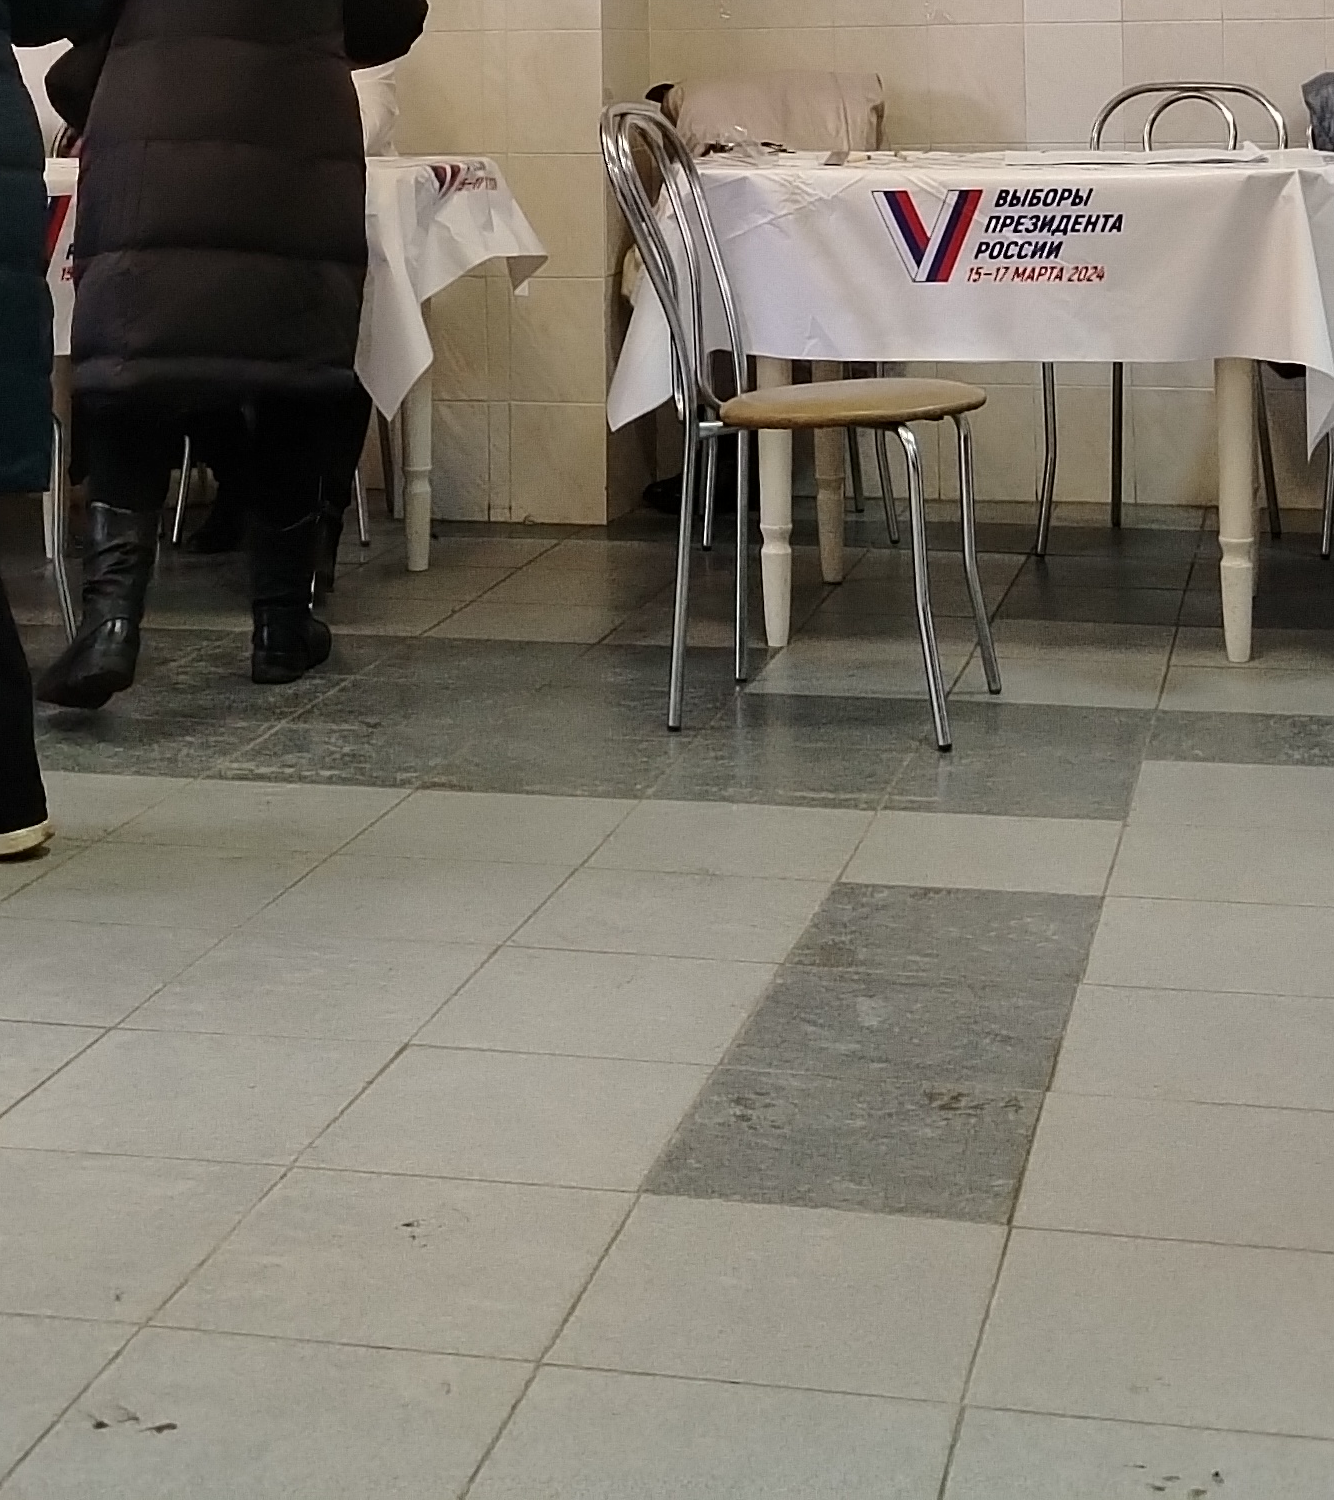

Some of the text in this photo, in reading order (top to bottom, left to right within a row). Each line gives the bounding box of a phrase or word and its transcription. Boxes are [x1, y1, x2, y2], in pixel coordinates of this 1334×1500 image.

[993, 187, 1094, 208] ВЫБОРЫ
[983, 213, 1124, 237] ПРЕЗИДЕНТА
[973, 240, 1064, 260] РОССИИ
[1012, 266, 1064, 283] МАРТА
[1067, 265, 1106, 282] 2024
